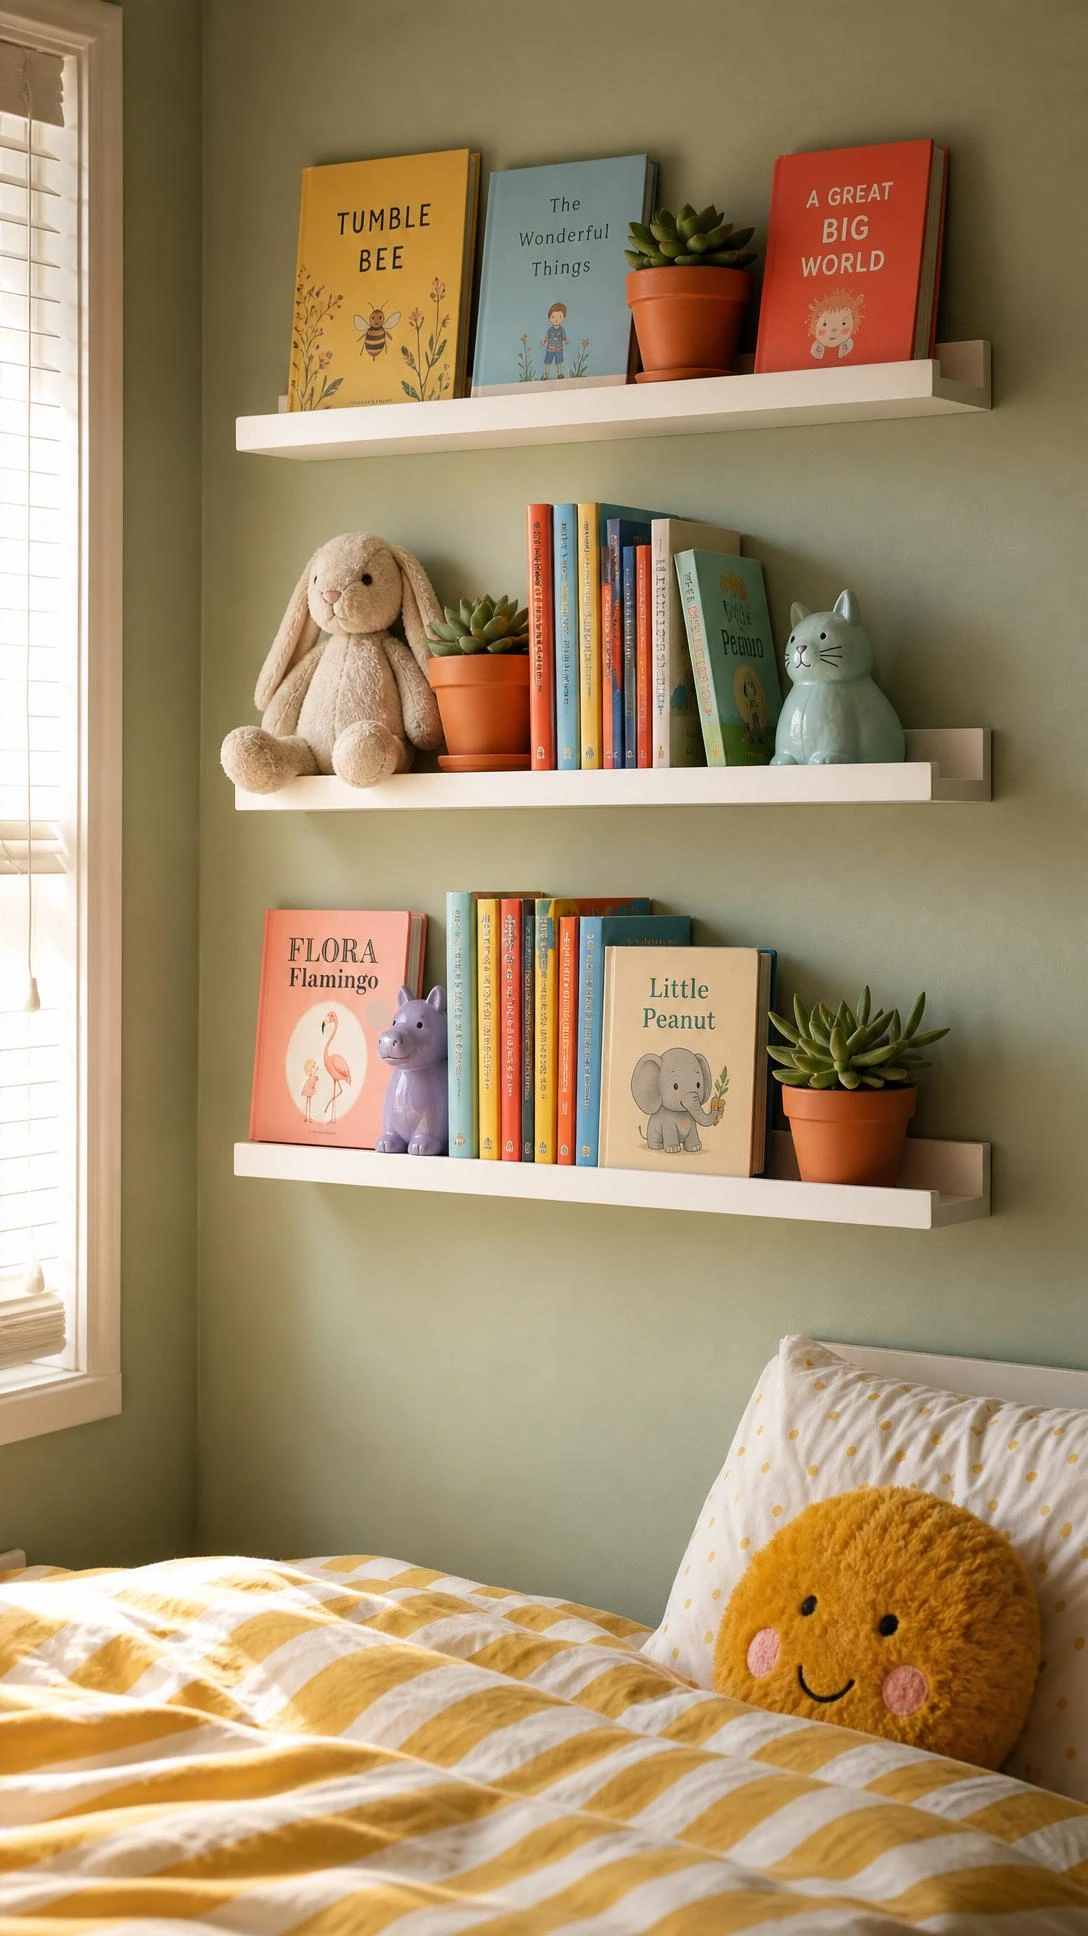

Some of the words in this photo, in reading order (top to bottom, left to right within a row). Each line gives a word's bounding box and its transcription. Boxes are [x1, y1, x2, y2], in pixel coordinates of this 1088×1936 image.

[549, 196, 581, 214] The
[806, 190, 819, 208] A
[827, 181, 894, 206] GREAT
[337, 203, 432, 235] TUMBLE
[822, 214, 869, 244] BIG
[519, 222, 610, 248] Wonderful
[358, 245, 404, 273] BEE
[531, 257, 592, 278] Things
[801, 250, 885, 278] WORLD
[287, 937, 379, 964] FLORA
[288, 967, 379, 995] Flamingo
[649, 977, 709, 999] Little
[642, 1007, 716, 1031] Peanut
